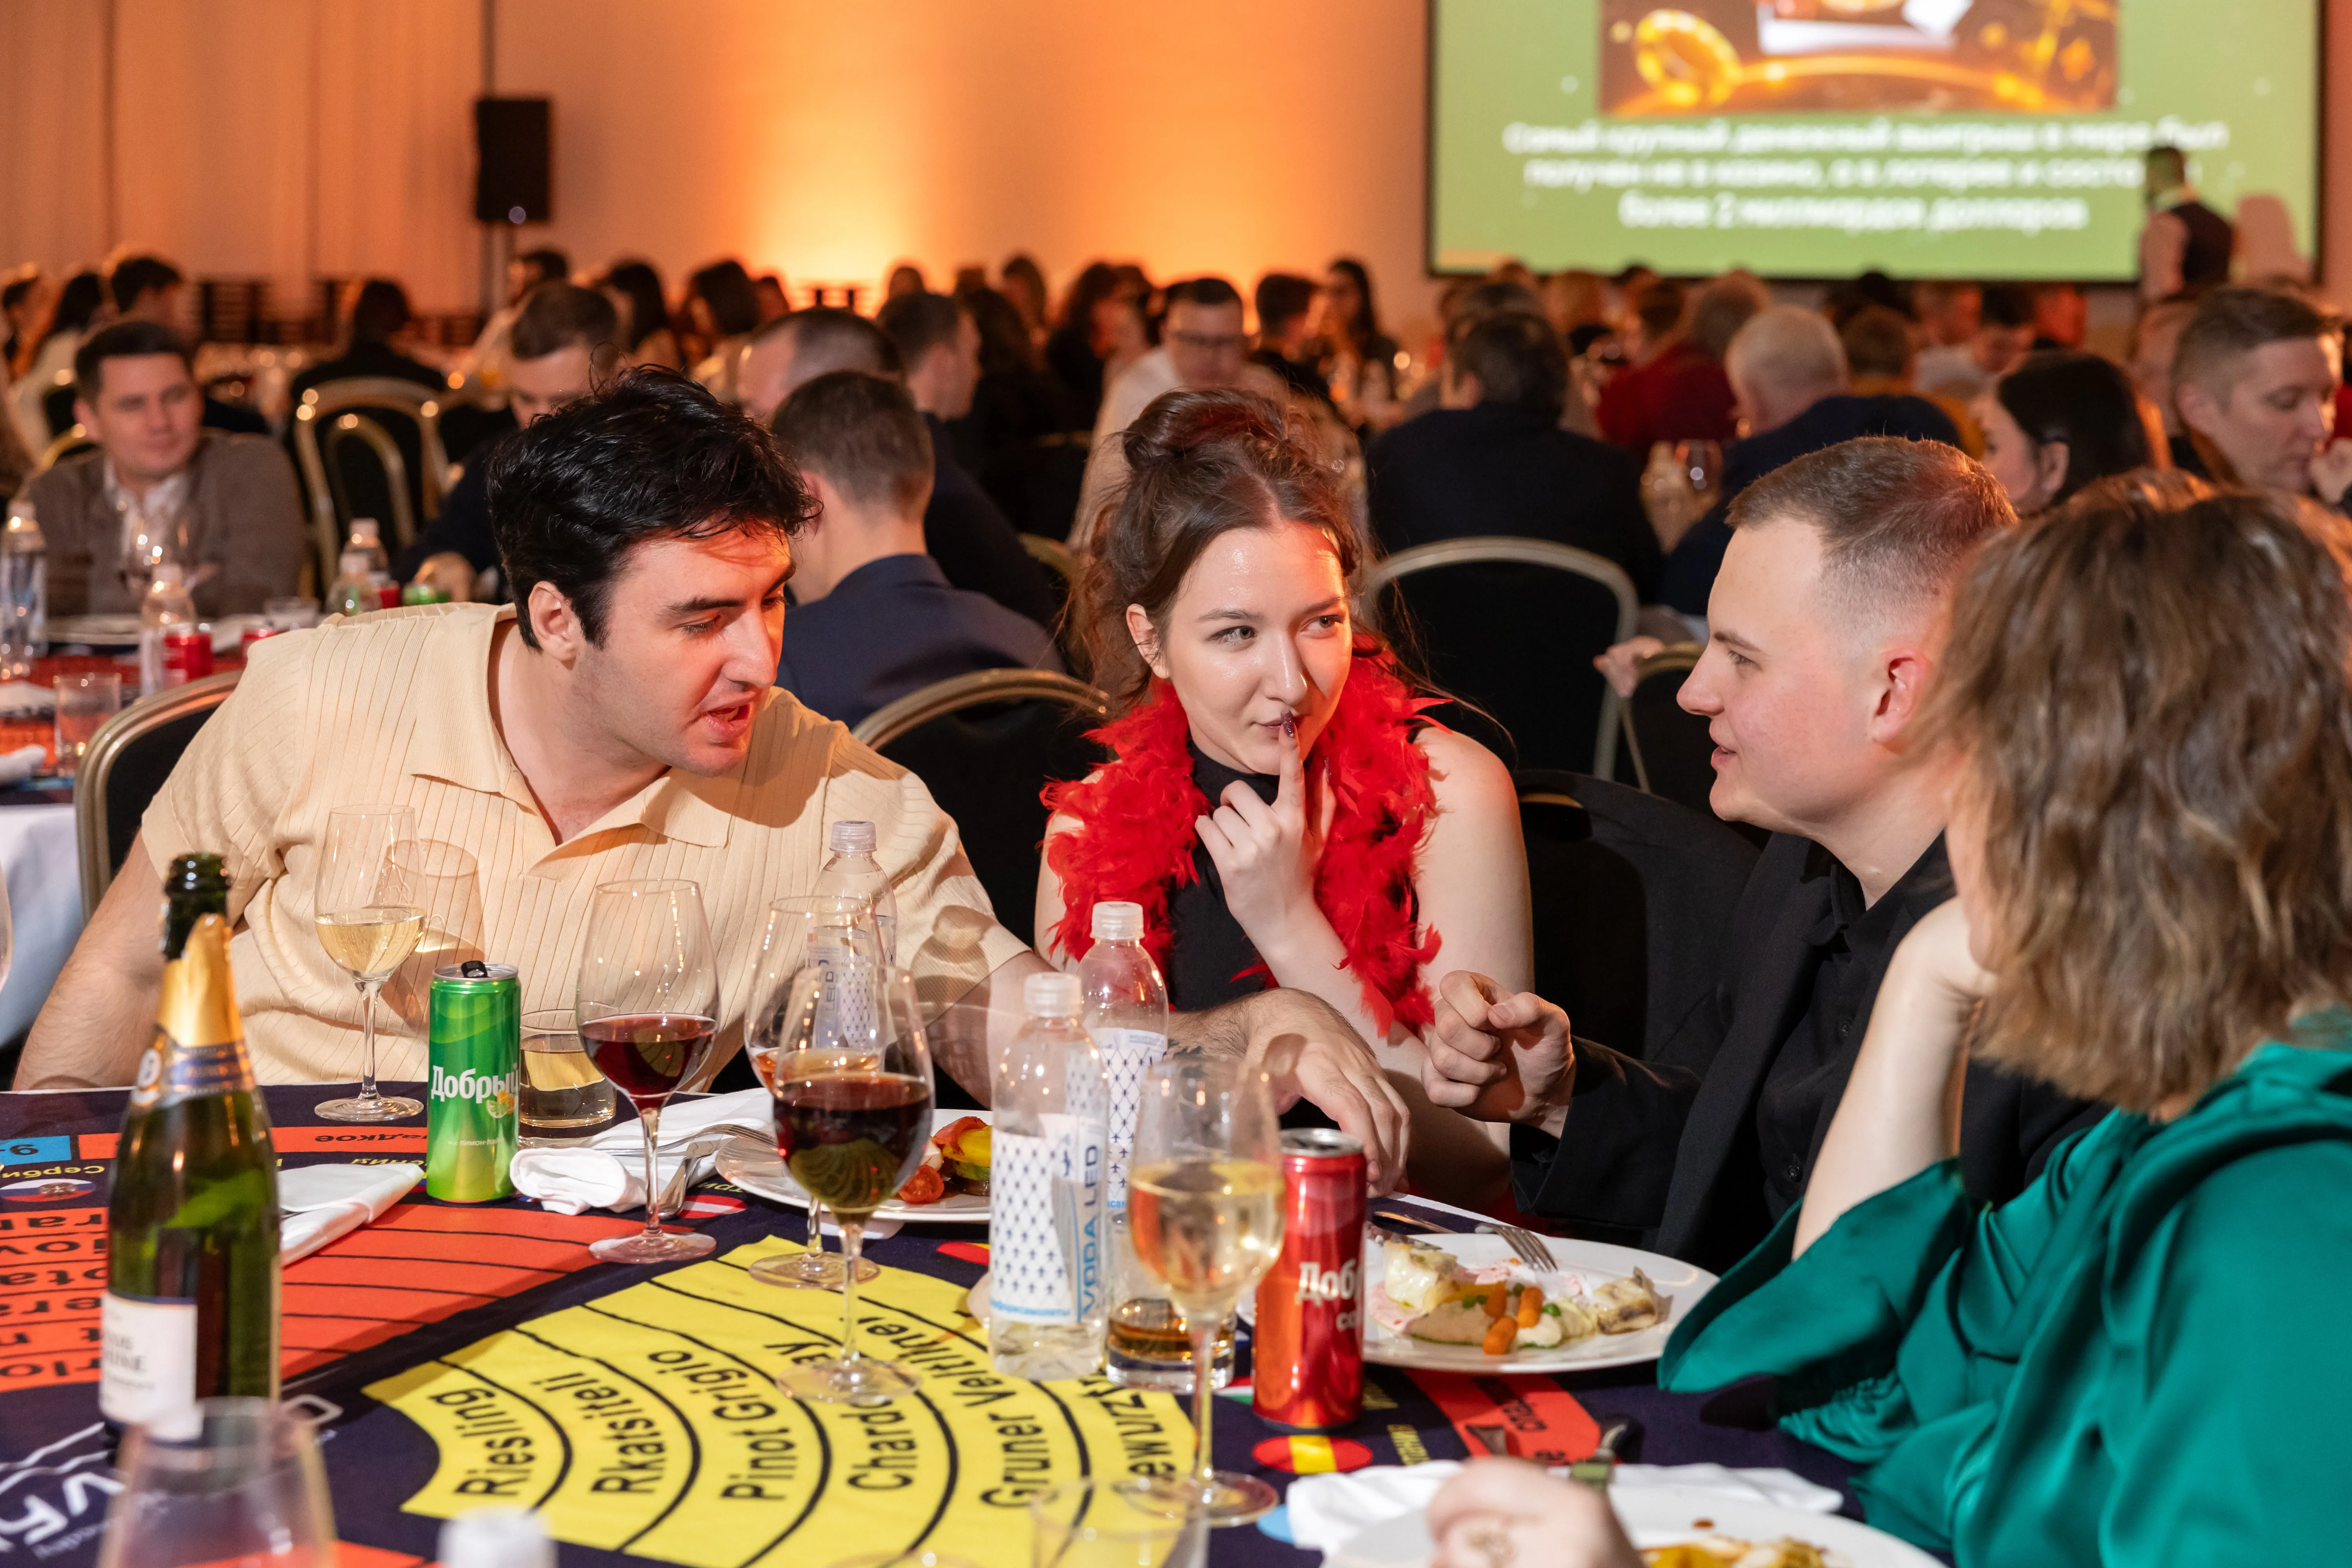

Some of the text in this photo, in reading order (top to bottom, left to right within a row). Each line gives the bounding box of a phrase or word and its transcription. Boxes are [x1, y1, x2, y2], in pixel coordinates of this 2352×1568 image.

[2, 1165, 105, 1178] Серби
[315, 1133, 428, 1142] адкое
[1082, 1145, 1098, 1313] VODA LED
[1295, 1258, 1362, 1308] Доб
[427, 1387, 536, 1496] Riesling
[530, 1372, 667, 1495] Rkatsiteli
[648, 1350, 797, 1501] Pinot Grigio
